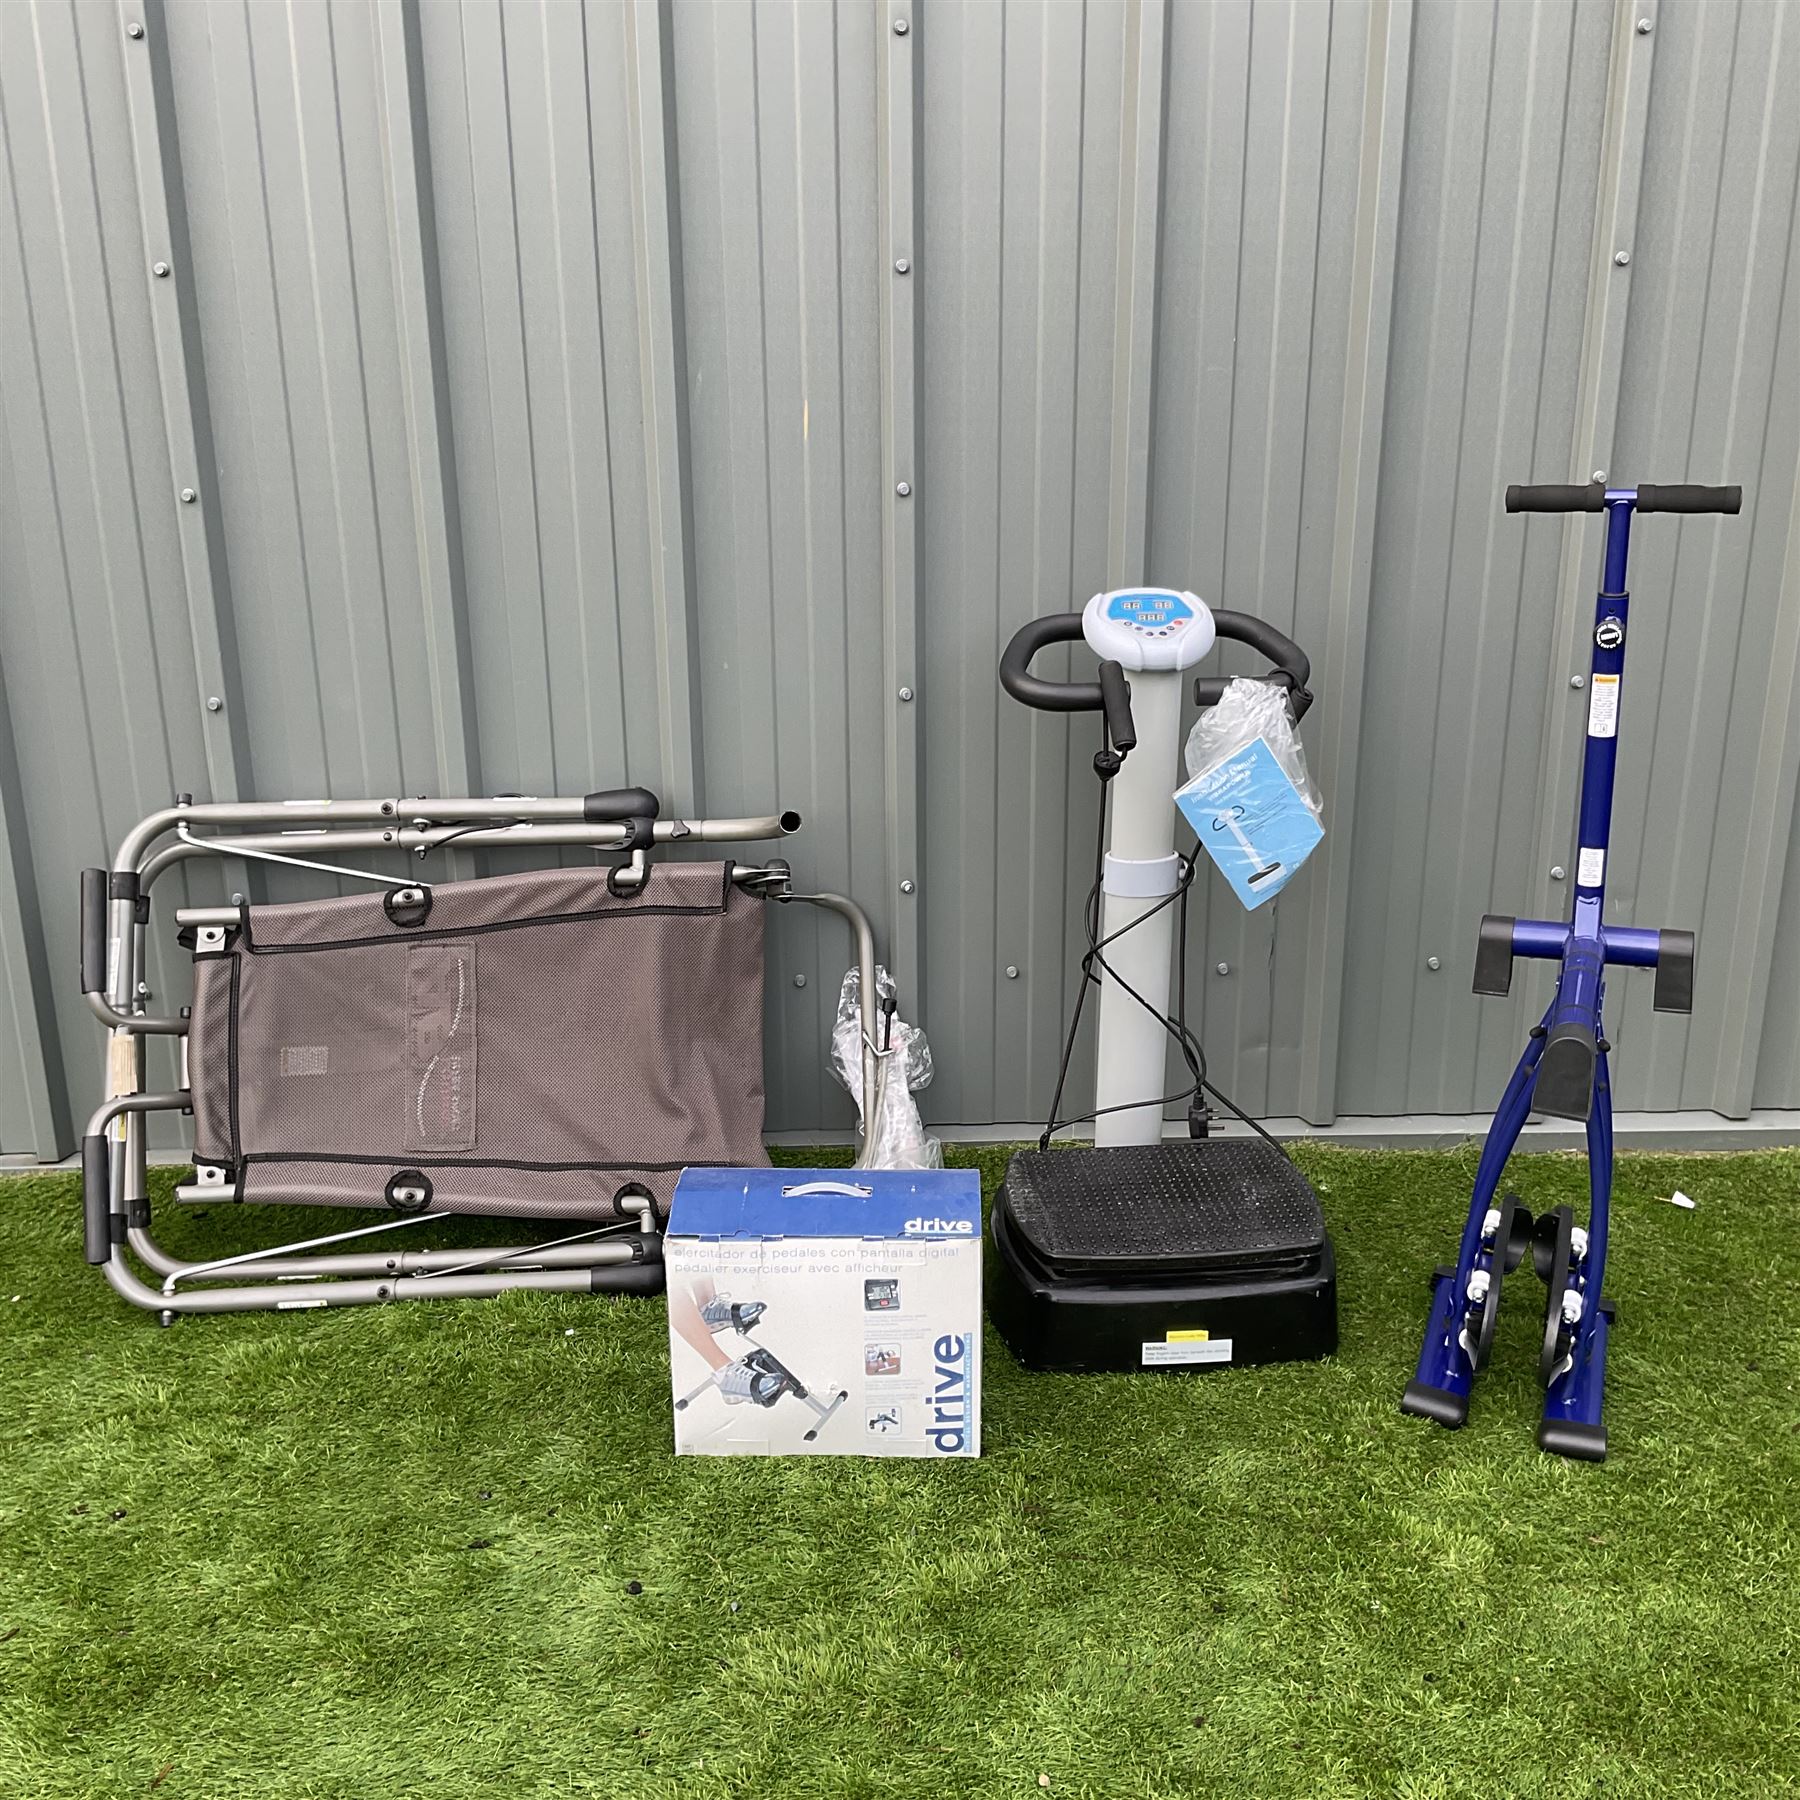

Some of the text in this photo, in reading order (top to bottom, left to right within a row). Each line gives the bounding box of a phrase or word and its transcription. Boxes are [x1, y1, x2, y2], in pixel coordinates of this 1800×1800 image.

[904, 1217, 973, 1232] drive
[674, 1247, 959, 1260] ejercitador de pedales con pantalla digital
[675, 1263, 903, 1274] pedalier exerciseur avec afficheur
[926, 1334, 965, 1453] drive
